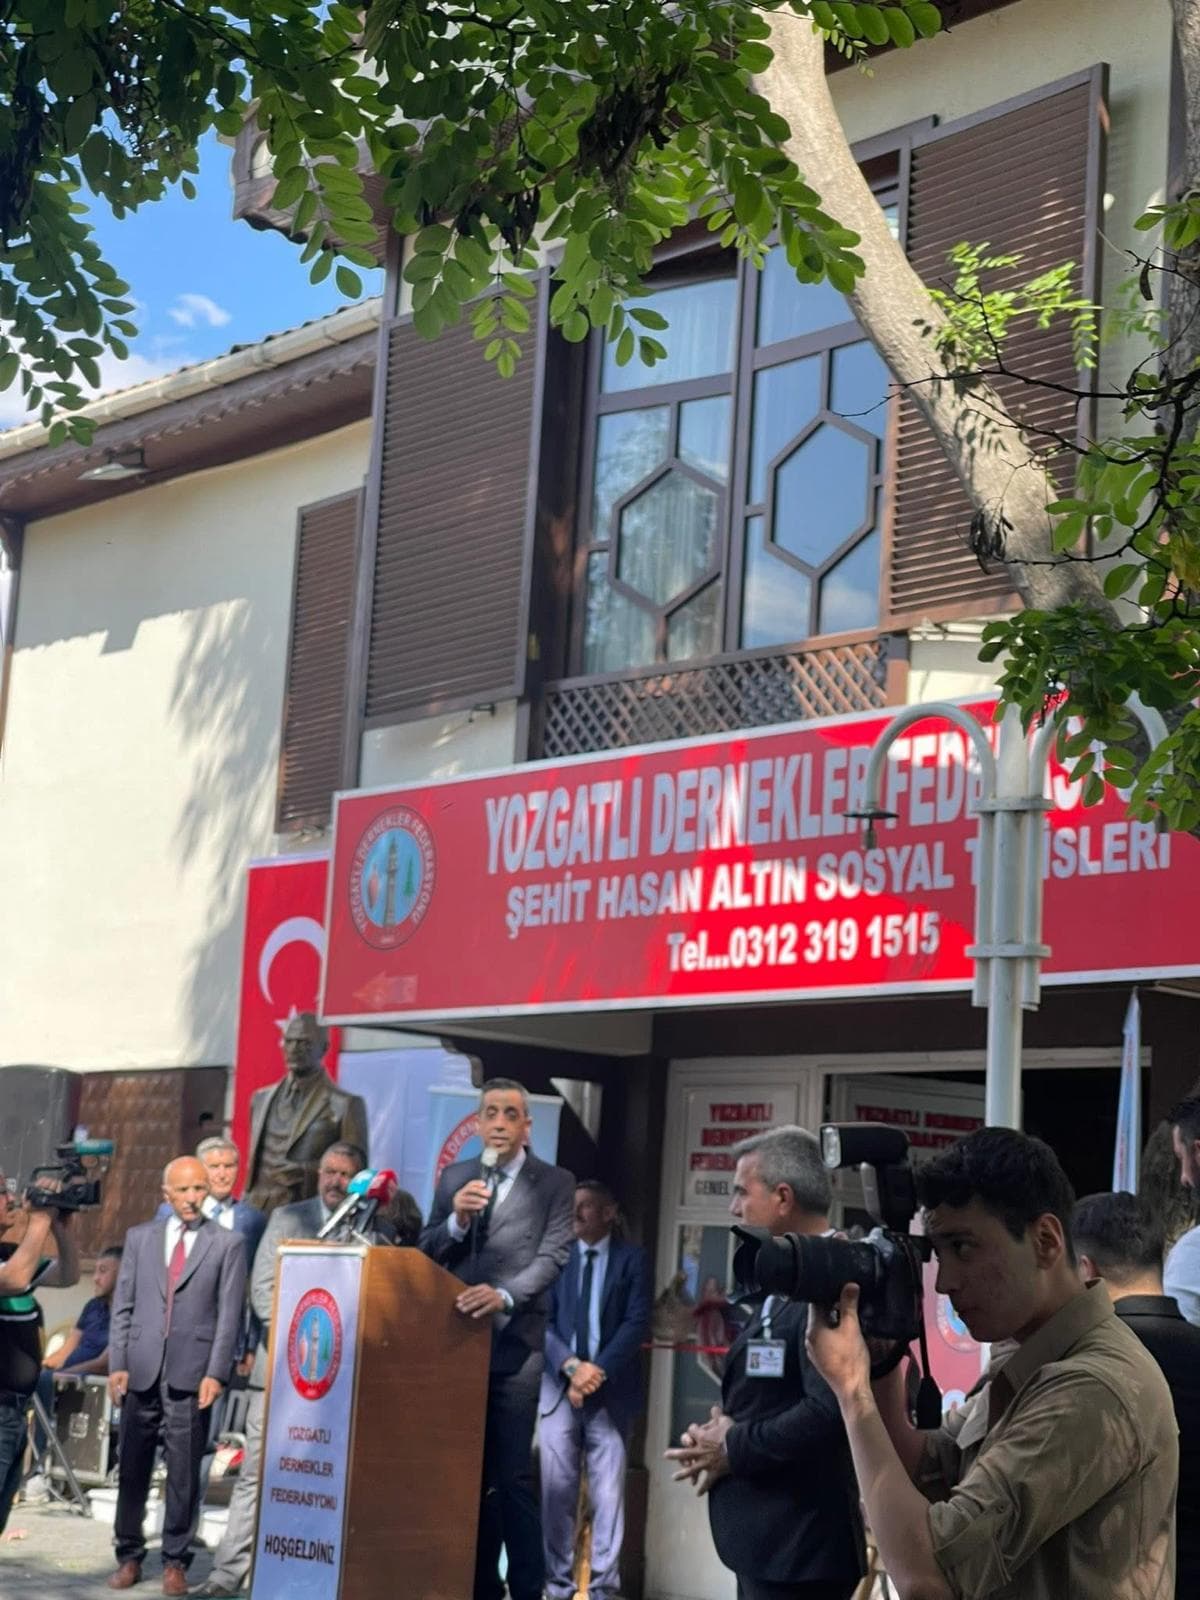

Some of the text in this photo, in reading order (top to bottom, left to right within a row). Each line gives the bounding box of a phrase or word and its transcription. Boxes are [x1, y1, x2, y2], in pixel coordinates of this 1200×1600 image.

[485, 776, 641, 875] YOZGATLI
[650, 744, 874, 857] DERNEKLER
[505, 870, 592, 939] ŞEHİT
[599, 866, 700, 920] HASAN
[708, 855, 807, 912] ALTIN
[815, 840, 955, 902] SOSYAL
[804, 917, 859, 963] 319
[866, 911, 939, 959] 1515
[279, 1457, 334, 1477] DERNEKLER
